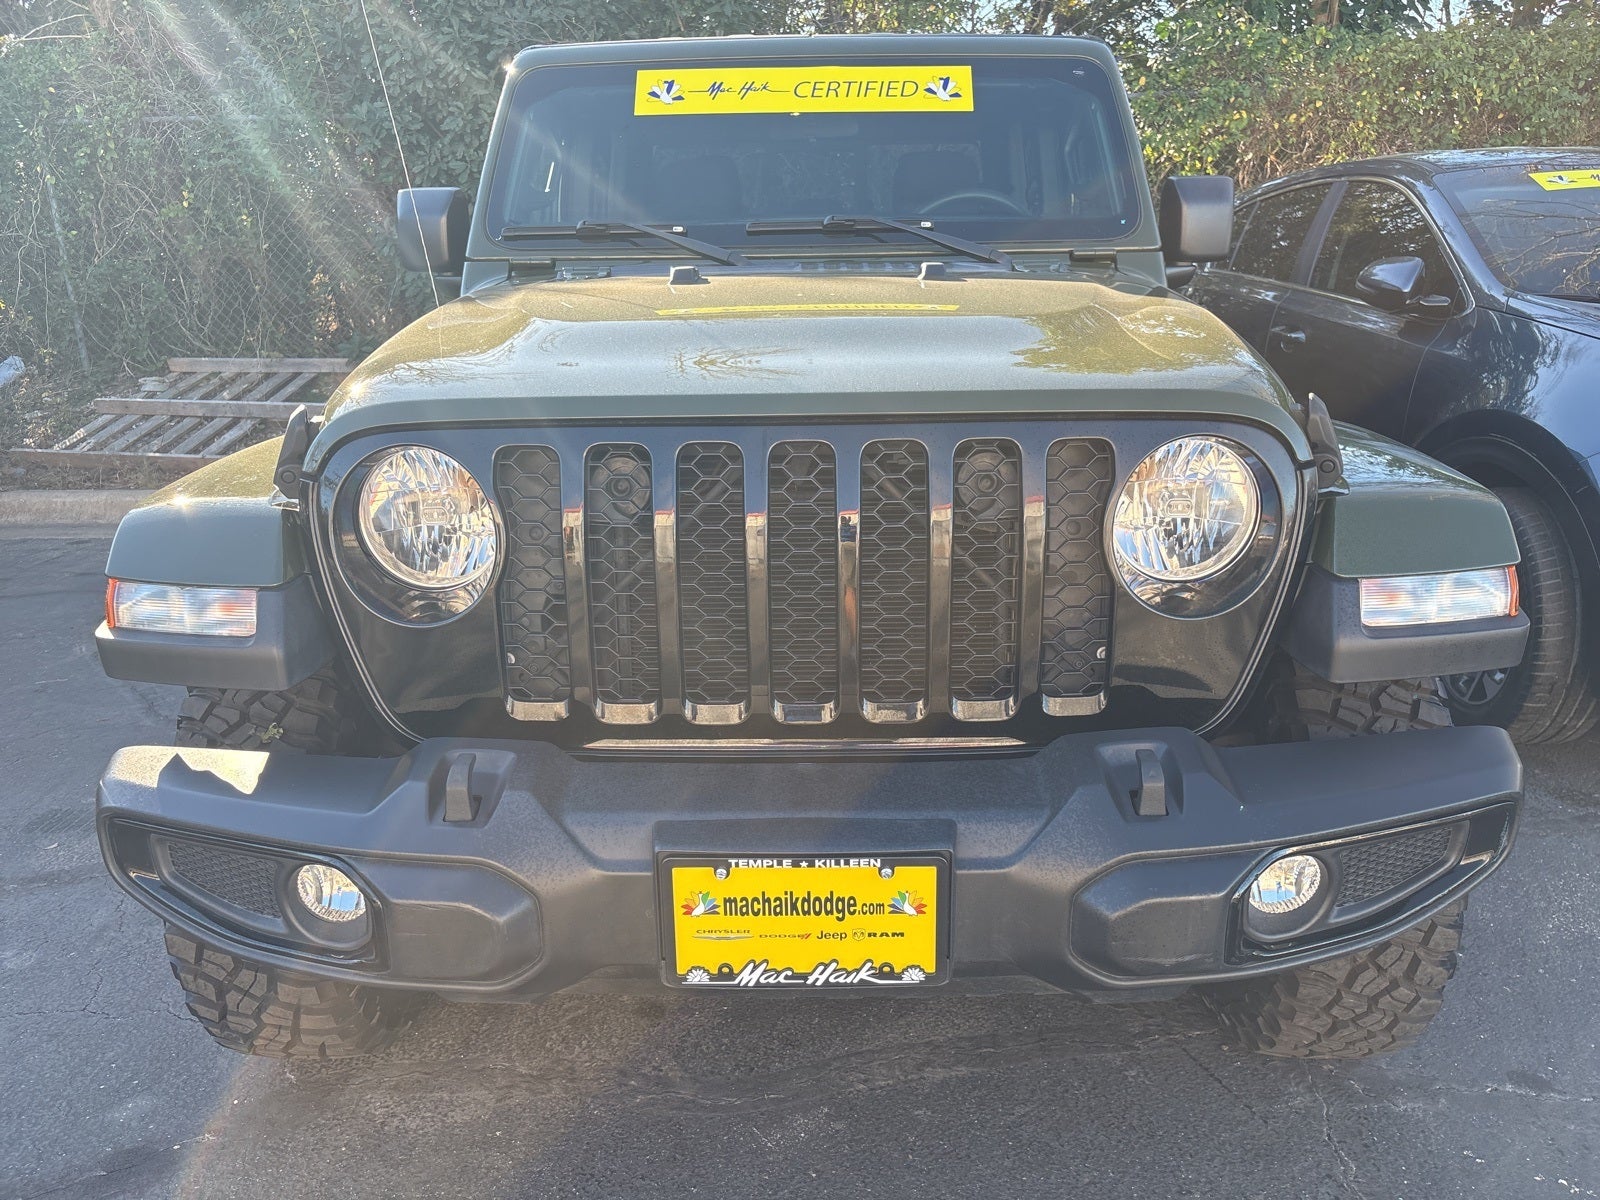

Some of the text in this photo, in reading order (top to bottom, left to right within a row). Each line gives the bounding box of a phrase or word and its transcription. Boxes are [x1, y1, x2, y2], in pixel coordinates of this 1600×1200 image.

[701, 80, 919, 100] Mac Haik CERTIFIED
[728, 858, 881, 868] TEMPLE KILLEEN
[723, 890, 885, 922] machaikdodge.com
[816, 930, 848, 941] Jeep
[736, 961, 882, 987] Mac Haik
